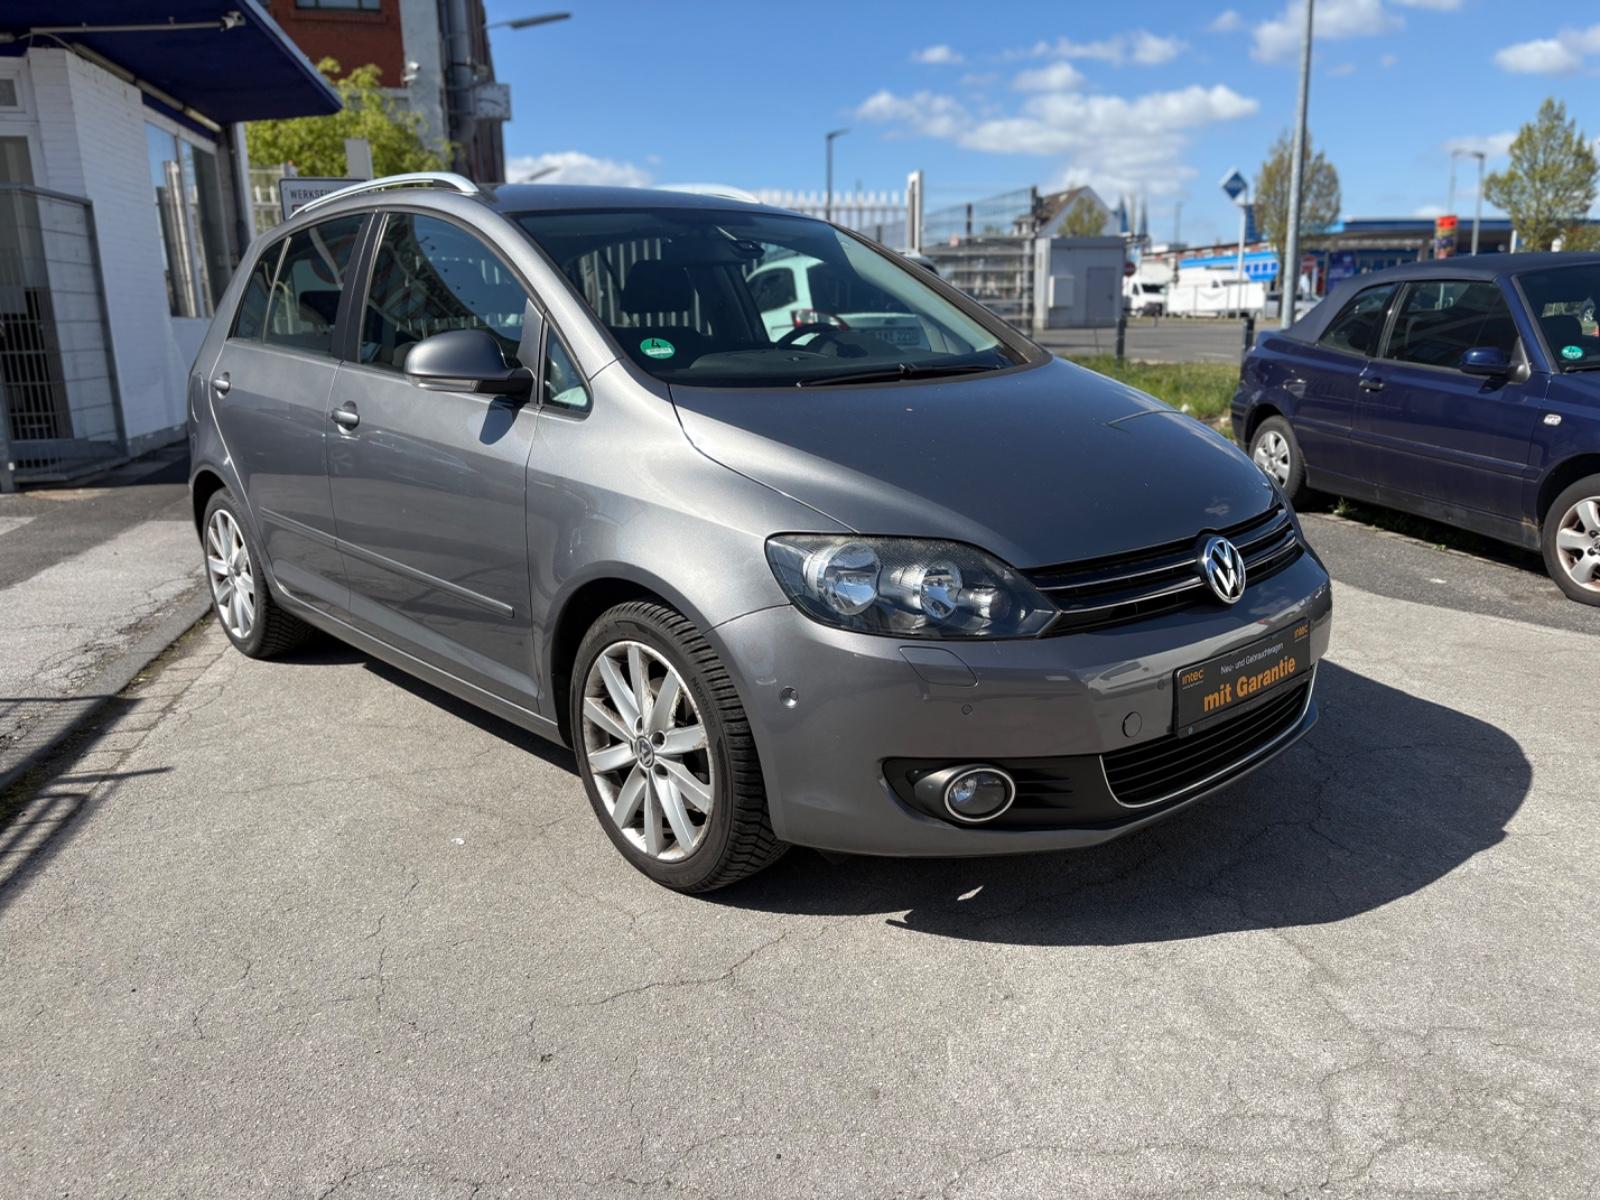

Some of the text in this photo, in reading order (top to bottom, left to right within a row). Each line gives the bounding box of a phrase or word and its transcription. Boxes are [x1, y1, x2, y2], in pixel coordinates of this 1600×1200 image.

[1235, 658, 1246, 669] und
[1203, 655, 1296, 712] mit Garantie
